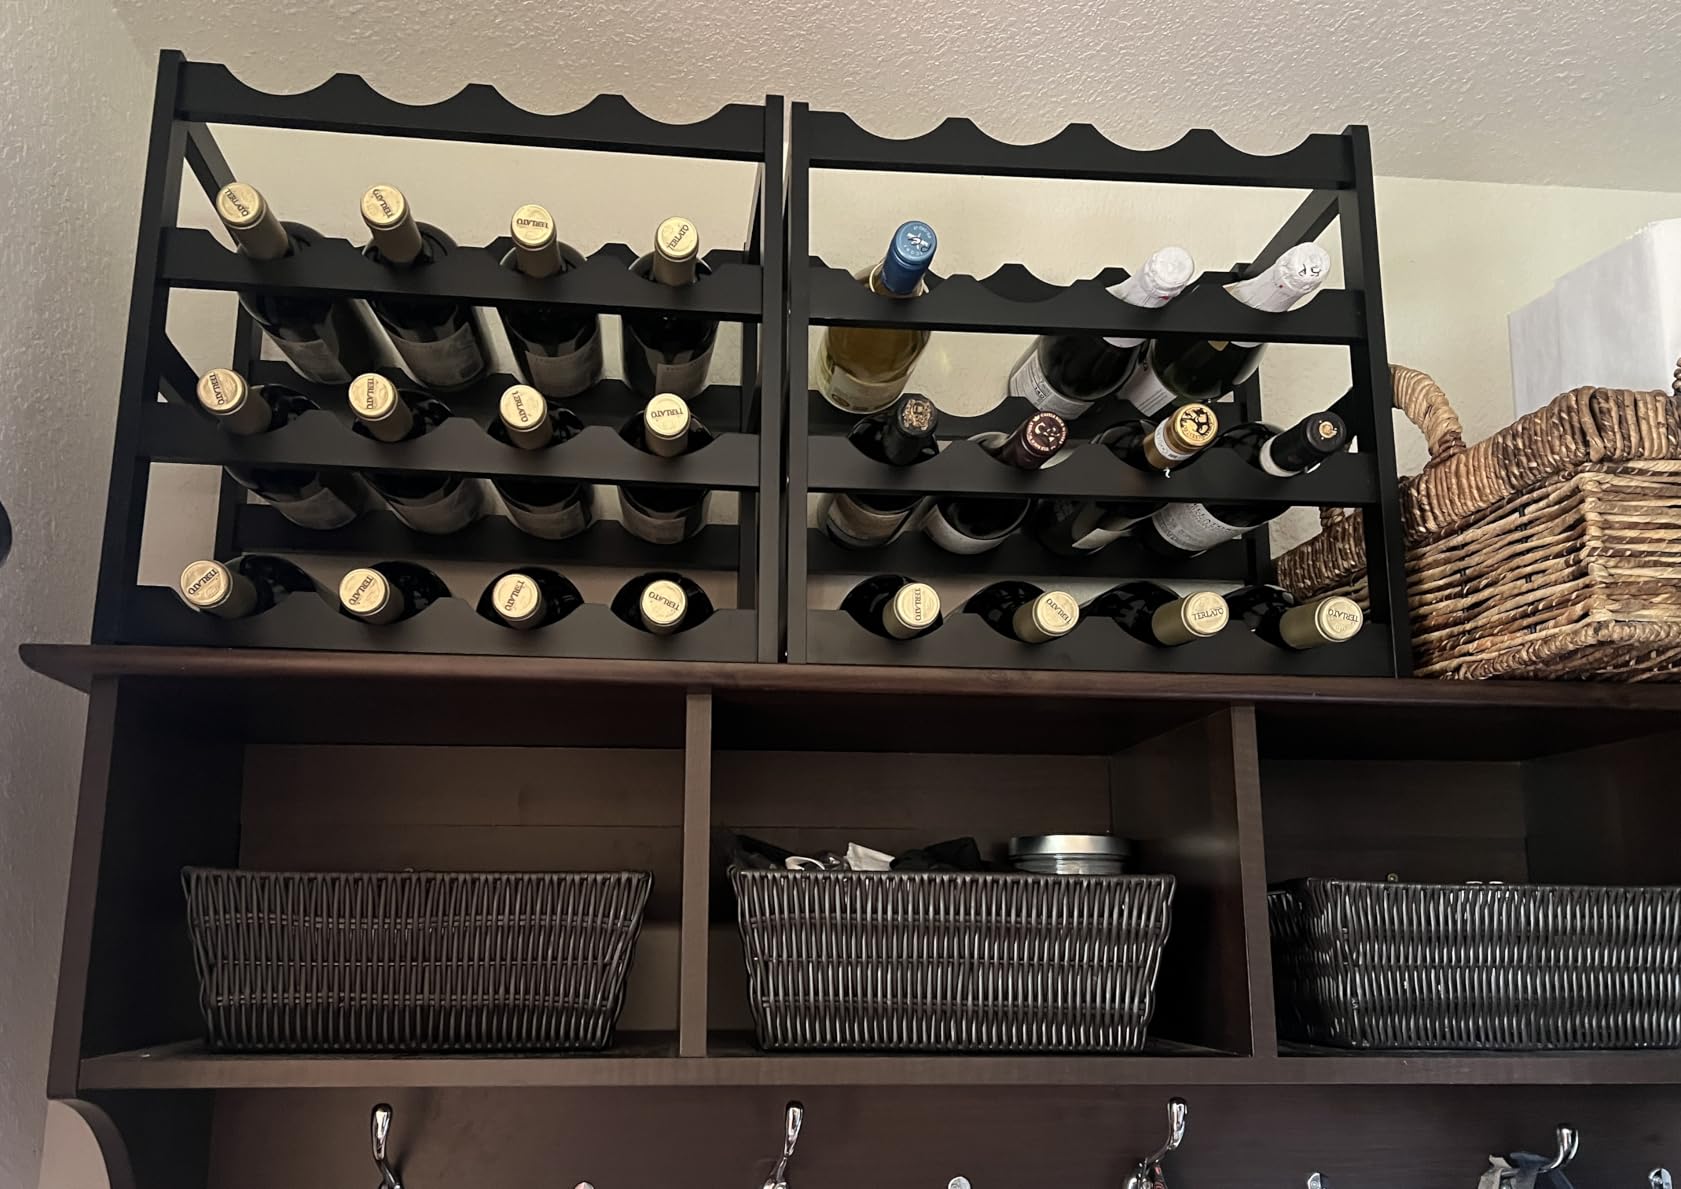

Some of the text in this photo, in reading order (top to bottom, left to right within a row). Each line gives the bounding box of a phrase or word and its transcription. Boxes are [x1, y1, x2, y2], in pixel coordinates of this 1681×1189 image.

[224, 188, 249, 217] TERLATO
[372, 189, 394, 219] TERLATO
[516, 218, 548, 229] TERLATO
[667, 224, 690, 250] TERLATO
[209, 372, 225, 406] TERLATO
[367, 377, 375, 410] TERLATO
[512, 391, 529, 423] TERLATO
[650, 407, 684, 419] TERLATO
[188, 568, 219, 595] TERLATO
[348, 575, 374, 605] TERLATO
[504, 580, 525, 612] TERLATO
[649, 591, 681, 611] TERLATO
[914, 588, 922, 621] TERLATO
[1046, 598, 1073, 625] TERLATO
[1192, 607, 1224, 621] TERLATO
[1328, 608, 1359, 623] TERLATO
